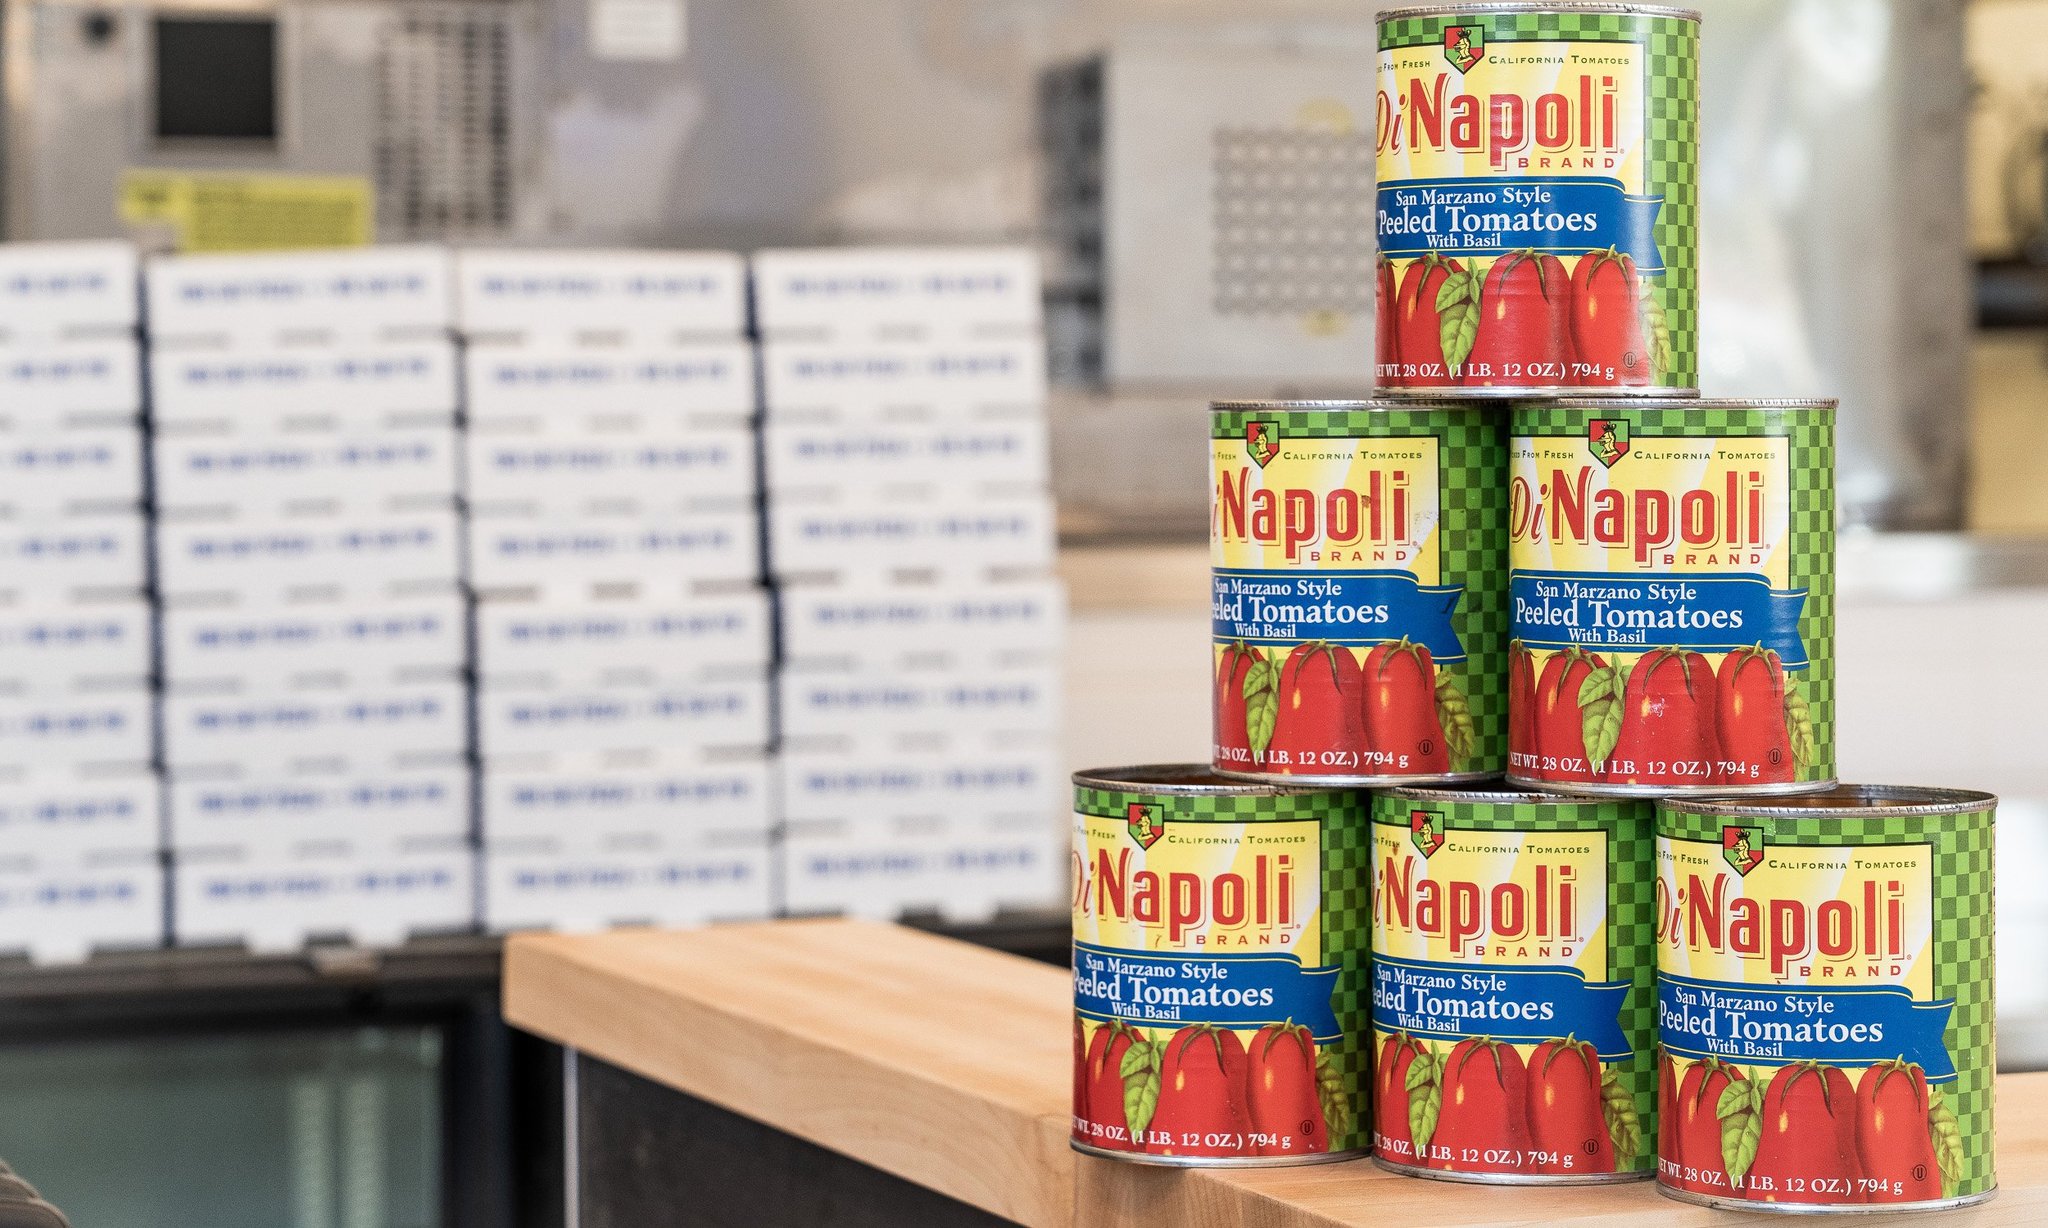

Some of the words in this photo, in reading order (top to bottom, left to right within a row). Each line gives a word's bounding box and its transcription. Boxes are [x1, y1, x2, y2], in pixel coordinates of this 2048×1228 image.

[1518, 157, 1615, 169] BRAND
[1396, 190, 1417, 206] San
[1421, 189, 1496, 205] Marzano
[1503, 186, 1551, 207] Style
[1378, 208, 1437, 235] Peeled
[1445, 206, 1597, 232] Tomatoes
[1426, 234, 1459, 248] With
[1463, 232, 1501, 248] Basil
[1403, 364, 1417, 377] 28
[1420, 363, 1444, 377] OZ.
[1469, 363, 1492, 378] LB.
[1503, 363, 1521, 377] 12
[1527, 362, 1567, 381] OZ.)
[1571, 363, 1601, 377] 794
[1605, 366, 1615, 380] g
[1311, 551, 1407, 562] BRAND
[1663, 554, 1761, 565] BRAND
[1231, 578, 1292, 596] Marzano
[1297, 579, 1342, 600] Style
[1536, 580, 1559, 598] San
[1562, 582, 1641, 600] Marzano
[1647, 582, 1697, 604] Style
[1248, 595, 1389, 624] Tomatoes
[1516, 596, 1580, 627] Peeled
[1587, 600, 1743, 629] Tomatoes
[1234, 623, 1261, 637] With
[1263, 623, 1297, 638] Basil
[1567, 627, 1602, 643] With
[1606, 628, 1647, 644] Basil
[1231, 747, 1250, 762] OZ.
[1268, 750, 1293, 764] LB.
[1299, 751, 1316, 764] 12
[1321, 751, 1359, 768] OZ.)
[1364, 751, 1394, 765] 794
[1398, 754, 1409, 768] g
[1523, 754, 1539, 769] WT.
[1542, 756, 1557, 770] 28
[1560, 757, 1586, 773] OZ.
[1611, 761, 1640, 775] LB.
[1647, 762, 1666, 775] 12
[1672, 760, 1711, 778] OZ.)
[1717, 761, 1745, 775] 794
[1750, 764, 1760, 778] g
[1196, 934, 1290, 945] BRAND
[1475, 946, 1573, 957] BRAND
[1085, 953, 1105, 971] San
[1107, 957, 1176, 978] Marzano
[1181, 962, 1228, 982] Style
[1800, 965, 1901, 977] BRAND
[1073, 966, 1122, 1001] Peeled
[1128, 976, 1274, 1007] Tomatoes
[1377, 964, 1391, 982] San
[1394, 967, 1456, 989] Marzano
[1461, 973, 1507, 995] Style
[1111, 1001, 1141, 1018] With
[1145, 1005, 1181, 1020] Basil
[1411, 986, 1554, 1021] Tomatoes
[1675, 986, 1698, 1006] San
[1700, 991, 1778, 1013] Marzano
[1784, 995, 1834, 1017] Style
[1397, 1012, 1424, 1029] With
[1427, 1016, 1461, 1032] Basil
[1659, 1000, 1717, 1037] Peeled
[1725, 1011, 1884, 1043] Tomatoes
[1706, 1038, 1739, 1056] With
[1743, 1040, 1784, 1057] Basil
[1090, 1122, 1104, 1137] 28
[1105, 1125, 1128, 1141] OZ.
[1149, 1131, 1175, 1146] LB.
[1181, 1133, 1200, 1147] 12
[1204, 1133, 1243, 1150] OZ.)
[1248, 1133, 1277, 1147] 794
[1281, 1135, 1291, 1148] g
[1393, 1139, 1412, 1155] OZ.
[1431, 1146, 1455, 1161] LB.
[1461, 1149, 1479, 1163] 12
[1483, 1150, 1522, 1167] OZ.)
[1527, 1151, 1559, 1165] 794
[1563, 1154, 1574, 1168] g
[1667, 1161, 1682, 1178] WT.
[1684, 1166, 1698, 1182] 28
[1700, 1169, 1726, 1186] OZ.
[1749, 1176, 1778, 1191] LB.
[1785, 1178, 1805, 1192] 12
[1811, 1177, 1852, 1195] OZ.)
[1858, 1178, 1888, 1193] 794
[1893, 1181, 1903, 1195] g
